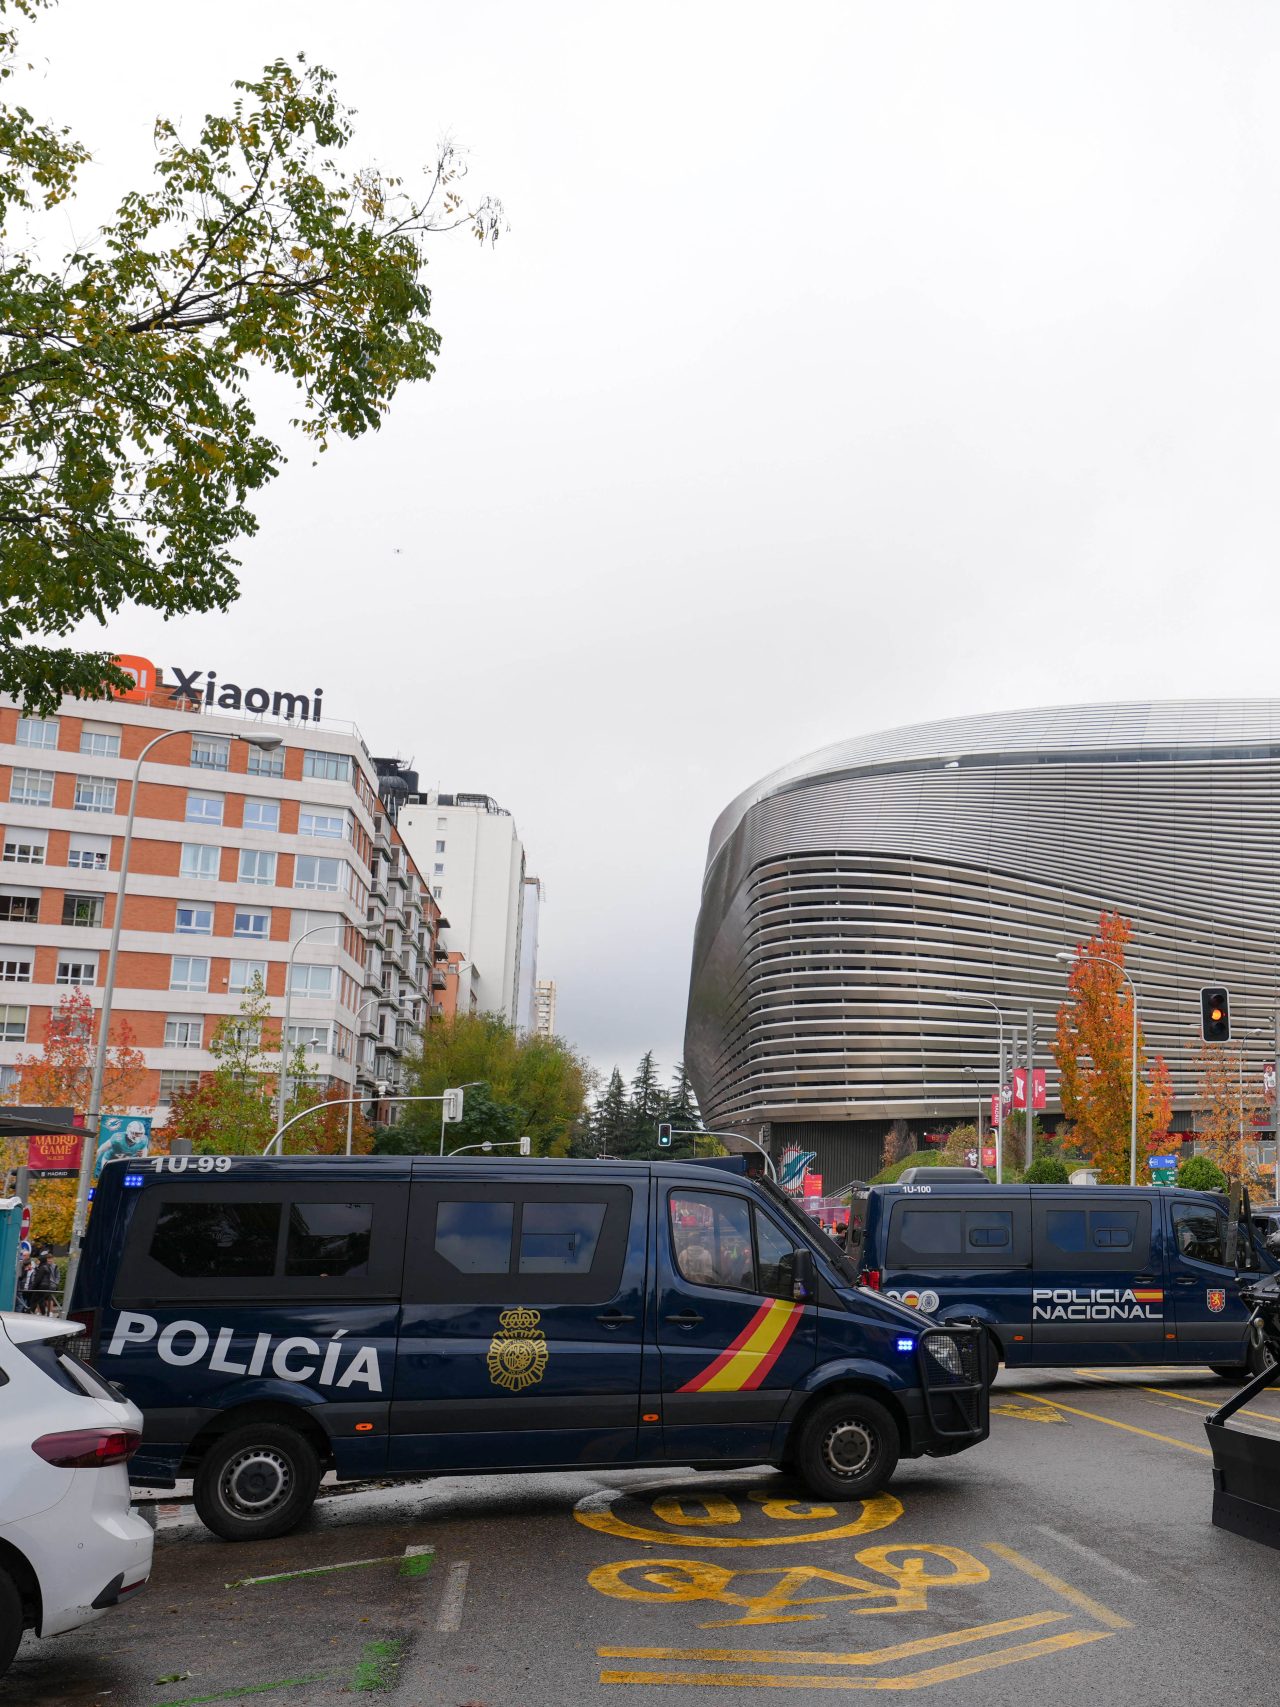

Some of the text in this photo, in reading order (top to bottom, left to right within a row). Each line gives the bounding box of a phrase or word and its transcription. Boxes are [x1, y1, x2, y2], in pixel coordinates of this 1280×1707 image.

[169, 666, 324, 723] Xiaomi
[35, 1135, 78, 1146] MADRID
[40, 1144, 72, 1155] GAME
[150, 1157, 232, 1173] 1U-99
[1033, 1304, 1164, 1320] NACIONAL
[107, 1310, 383, 1393] POLICÍA
